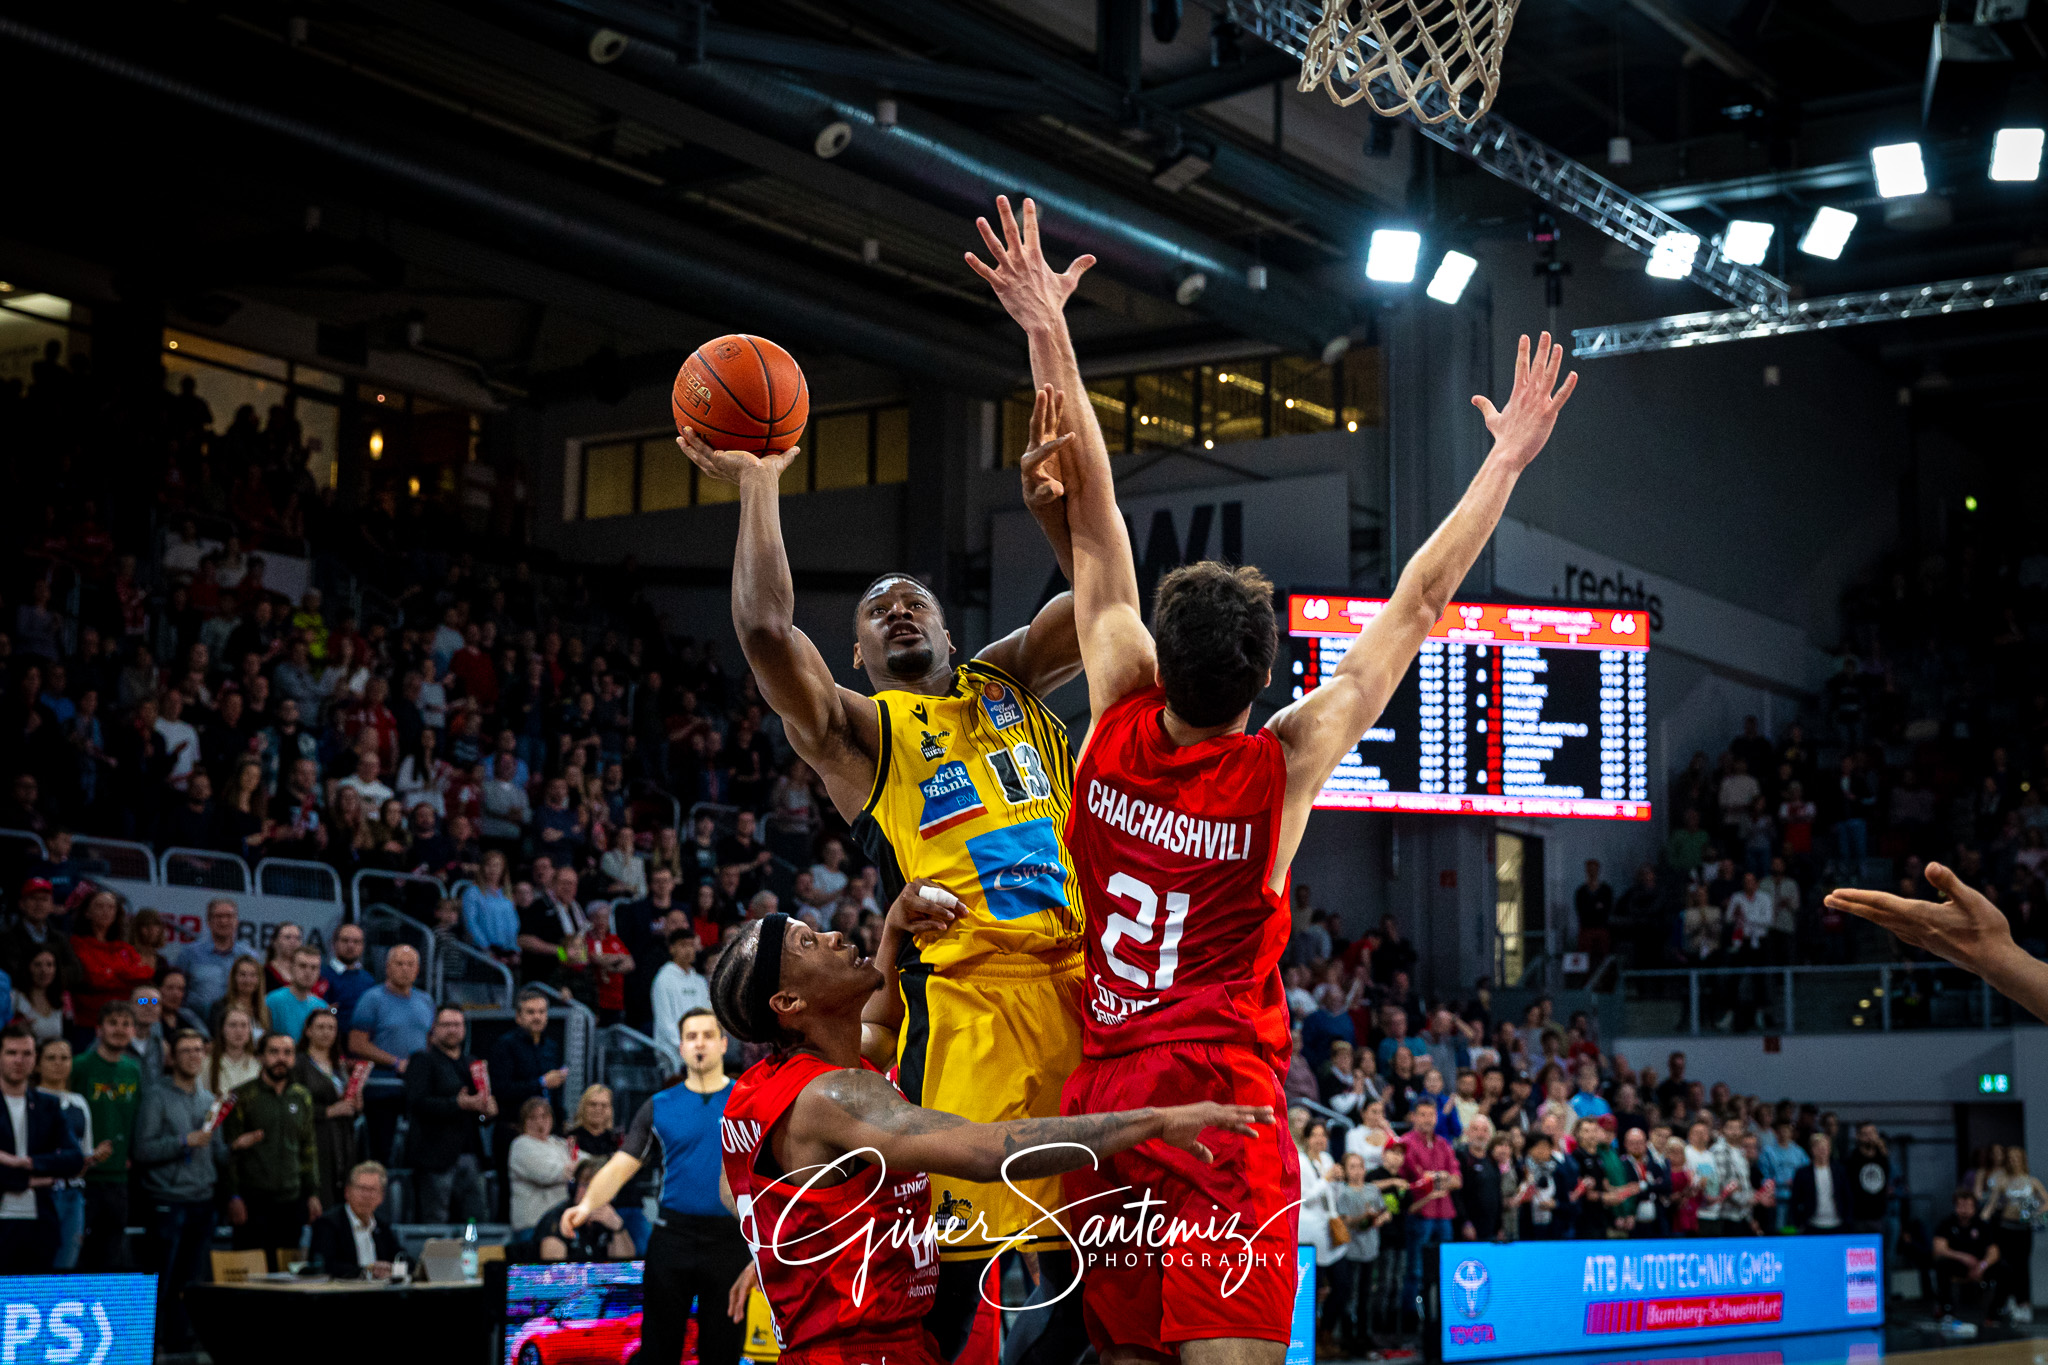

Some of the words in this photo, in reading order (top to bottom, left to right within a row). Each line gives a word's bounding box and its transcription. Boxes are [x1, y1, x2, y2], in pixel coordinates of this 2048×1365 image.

[995, 709, 1020, 726] BBL
[923, 776, 972, 799] Bank
[985, 741, 1051, 806] 13
[955, 790, 977, 807] BW
[1087, 779, 1252, 861] CHACHASHVILI
[1100, 871, 1191, 990] 21
[1582, 1254, 1617, 1292] ATB
